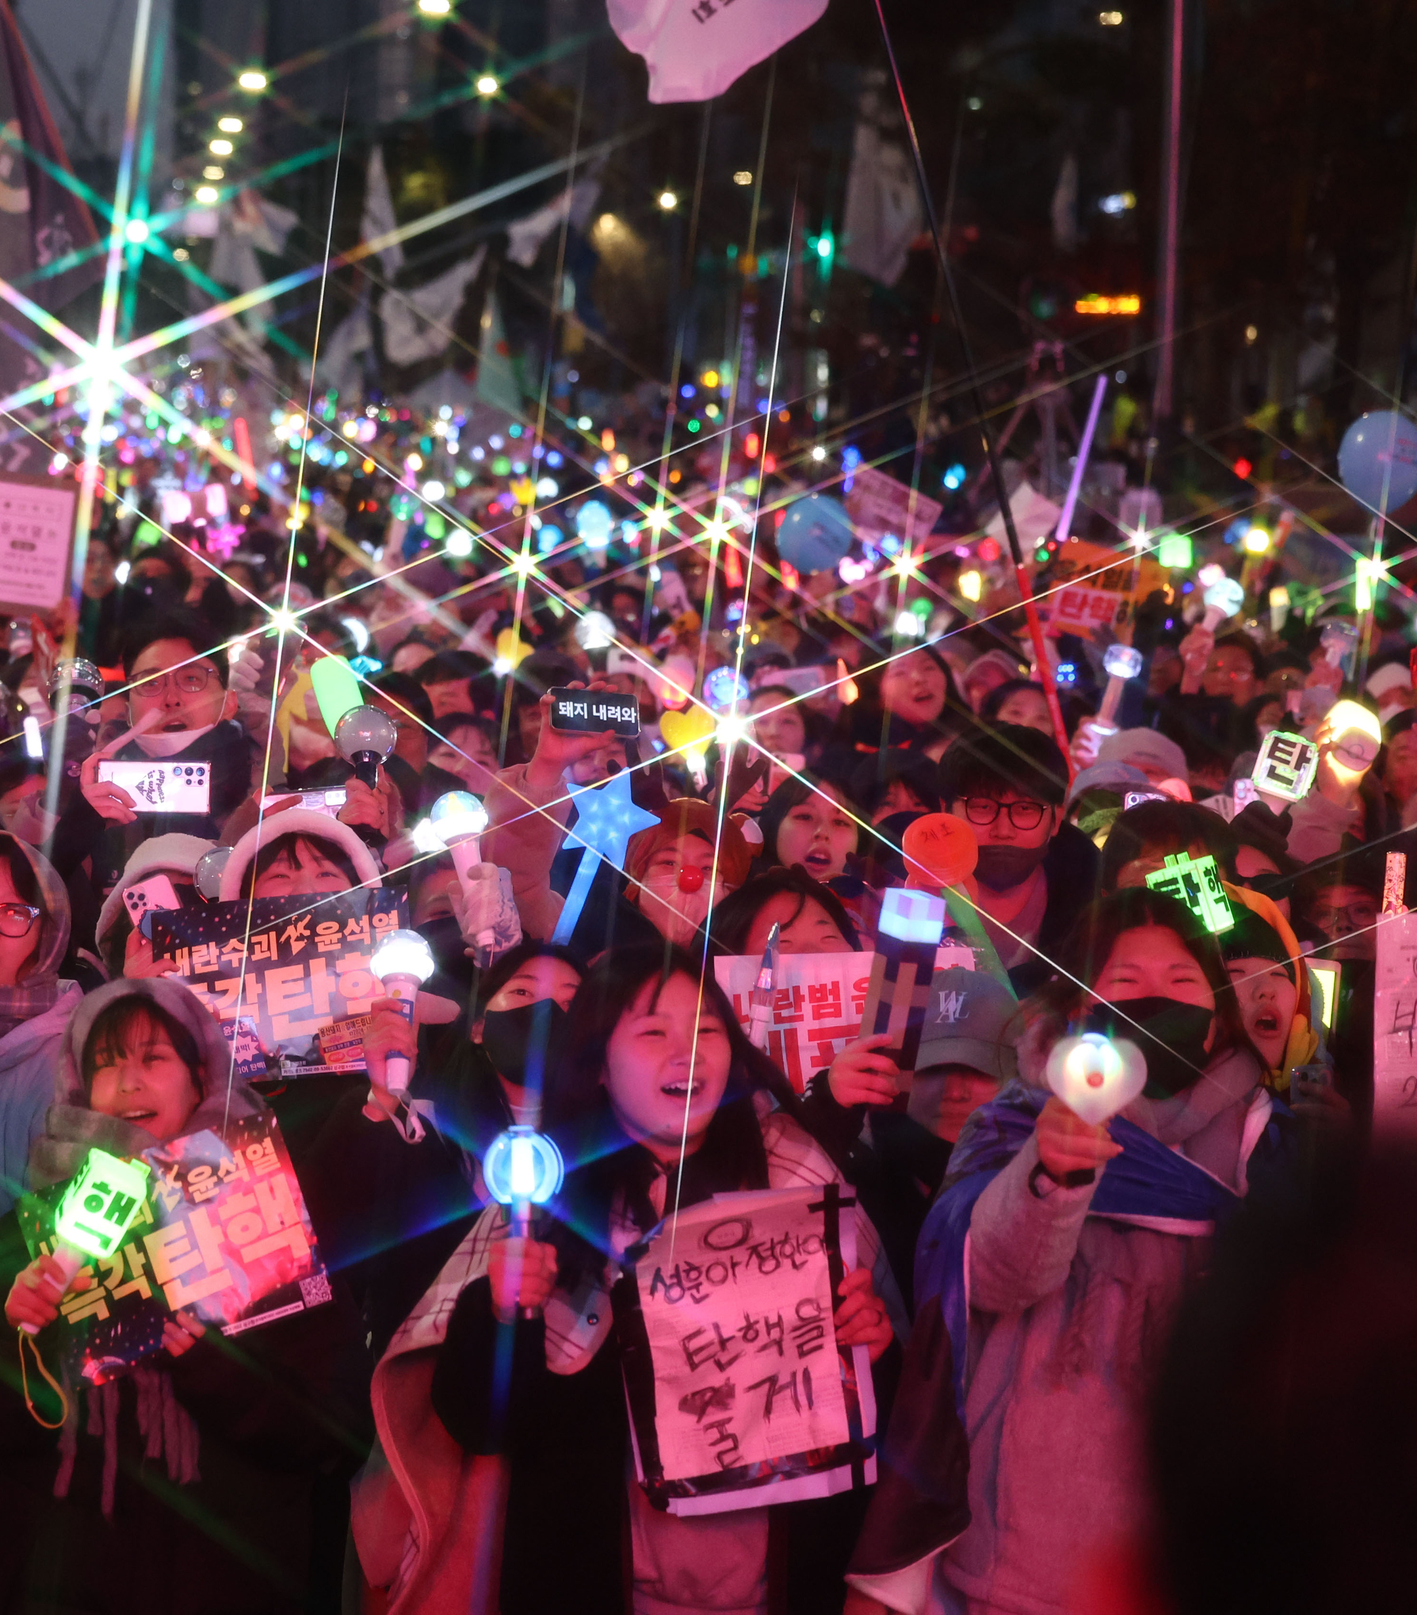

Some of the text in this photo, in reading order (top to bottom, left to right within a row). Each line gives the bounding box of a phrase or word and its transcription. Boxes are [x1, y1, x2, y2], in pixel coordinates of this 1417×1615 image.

[558, 701, 637, 724] 돼지 내려와
[1267, 736, 1311, 787] 탄
[1202, 863, 1231, 913] 핵
[163, 908, 401, 978] 내란수괴 윤석열
[187, 1136, 282, 1204] 윤석열
[72, 1180, 138, 1251] 핵
[142, 1172, 312, 1312] 탄핵
[678, 1297, 827, 1373] 탄핵을
